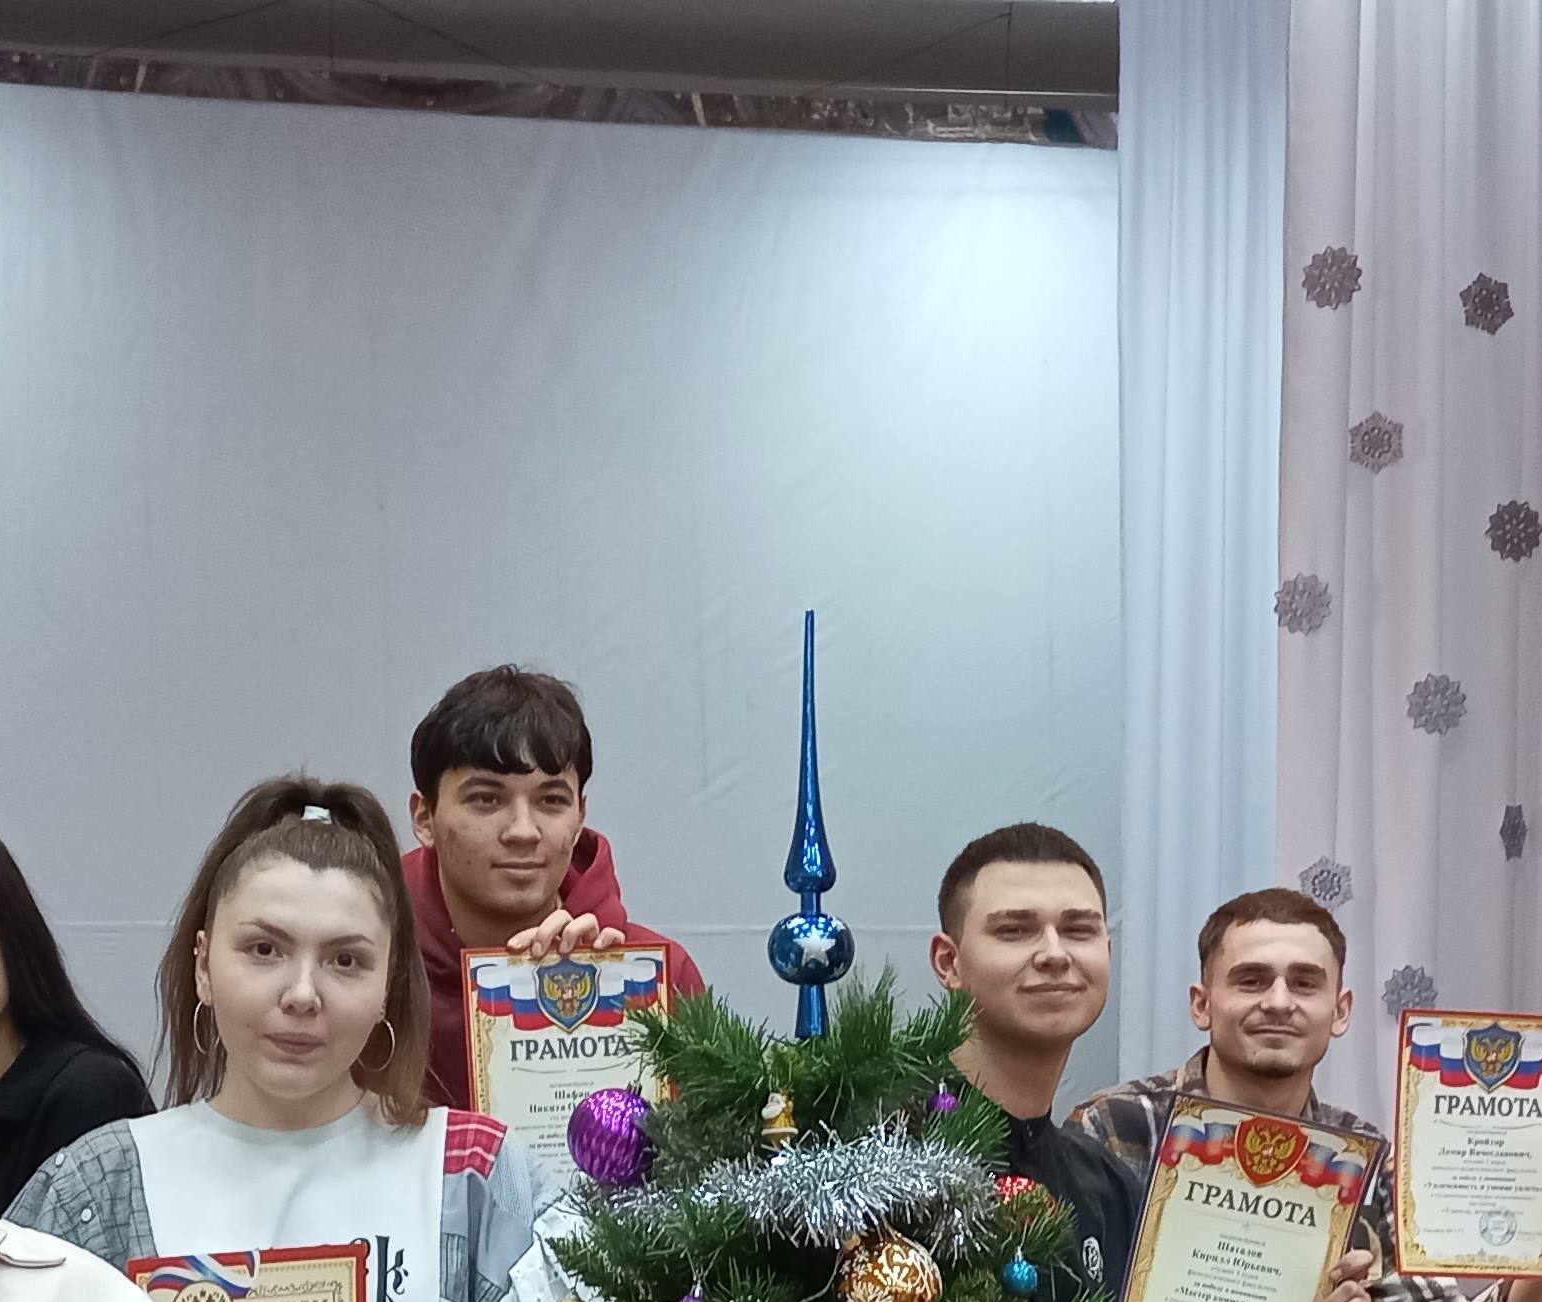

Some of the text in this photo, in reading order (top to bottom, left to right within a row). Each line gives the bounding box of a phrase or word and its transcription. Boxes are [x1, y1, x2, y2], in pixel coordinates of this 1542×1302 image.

[510, 1036, 630, 1061] ГРАМОТА
[1434, 1095, 1542, 1118] ГРАМОТА
[1185, 1180, 1316, 1227] ГРАМОТА
